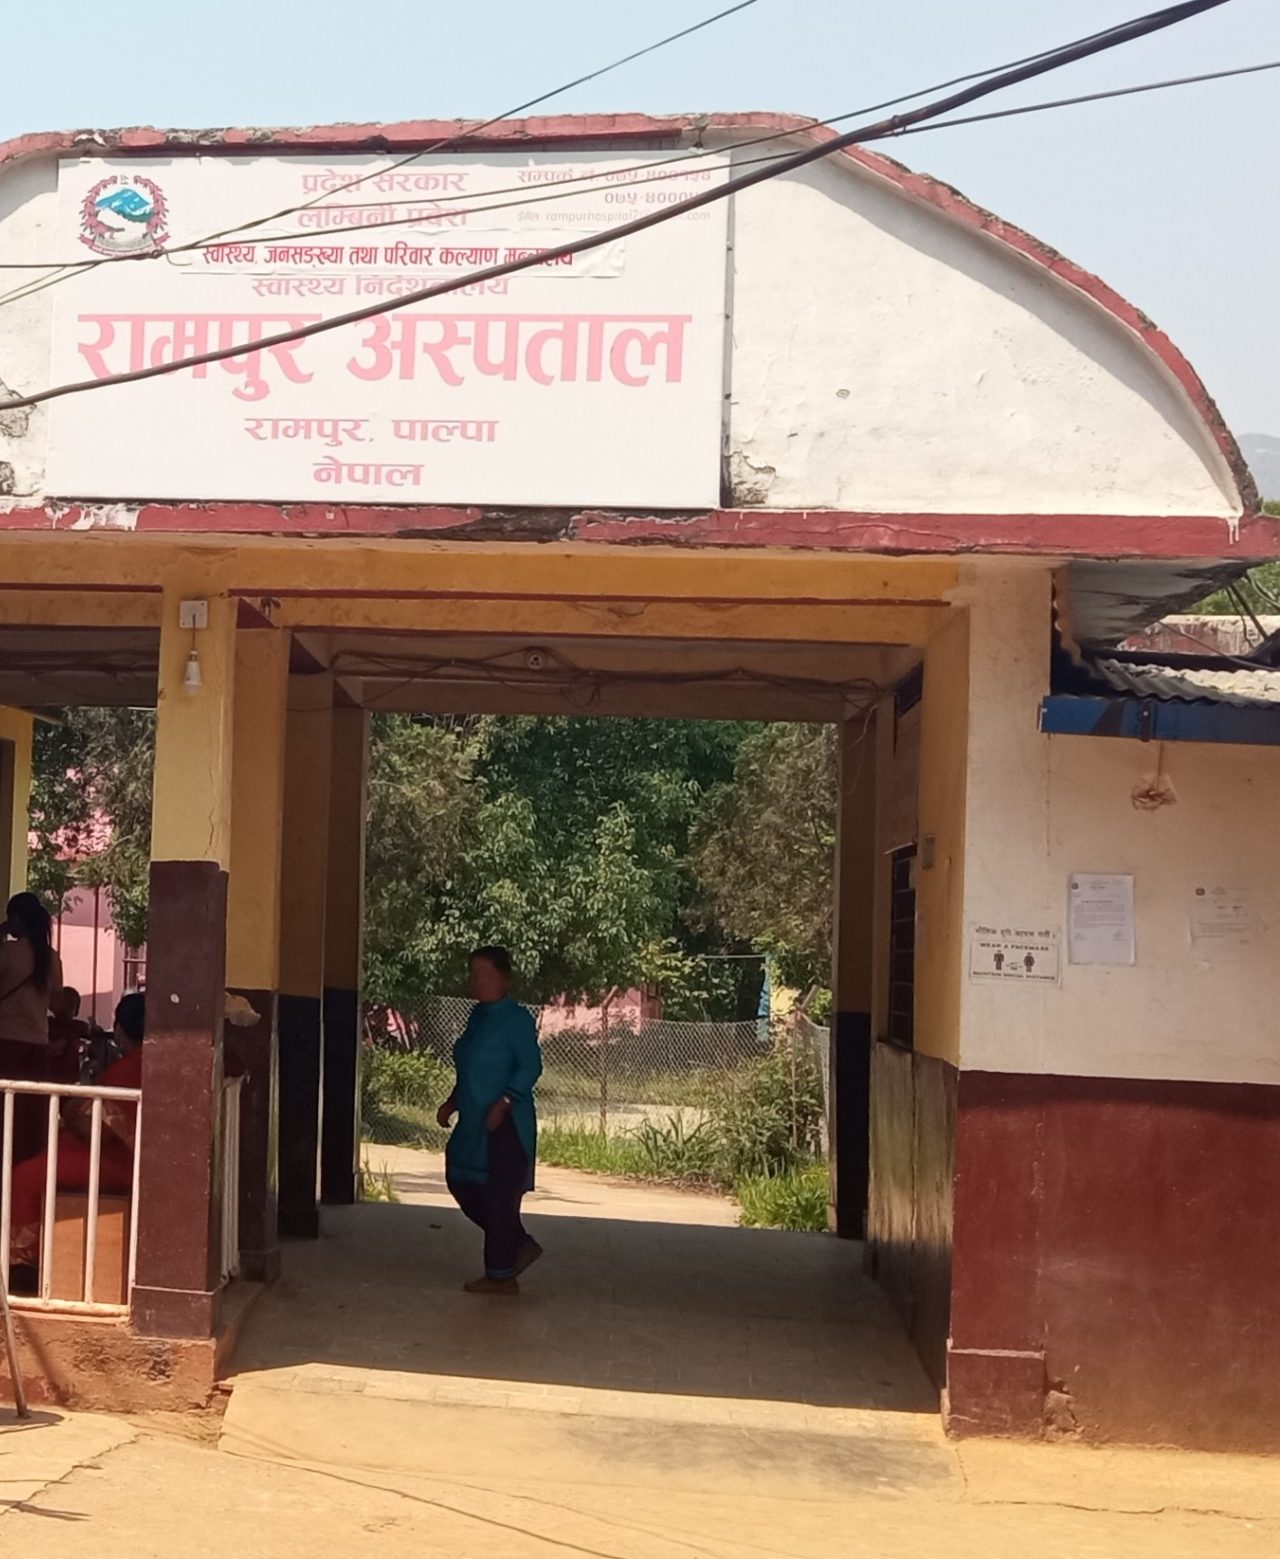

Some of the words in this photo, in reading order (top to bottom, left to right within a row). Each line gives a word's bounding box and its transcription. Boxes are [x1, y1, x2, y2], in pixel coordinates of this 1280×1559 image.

[301, 168, 364, 195] प्रदेश
[373, 172, 471, 193] सरकार
[604, 191, 710, 206] ०७५-४०००
[296, 202, 398, 230] लुम्बिनी
[406, 200, 471, 229] प्रदेश
[350, 246, 378, 266] तथा
[383, 240, 434, 267] परिवार
[440, 246, 498, 266] कल्याण
[252, 276, 346, 297] स्वास्थ्य
[77, 312, 322, 403] रामपुर
[345, 312, 693, 388] अस्पताल
[391, 418, 500, 443] पाल्पा
[312, 455, 426, 487] नेपाल
